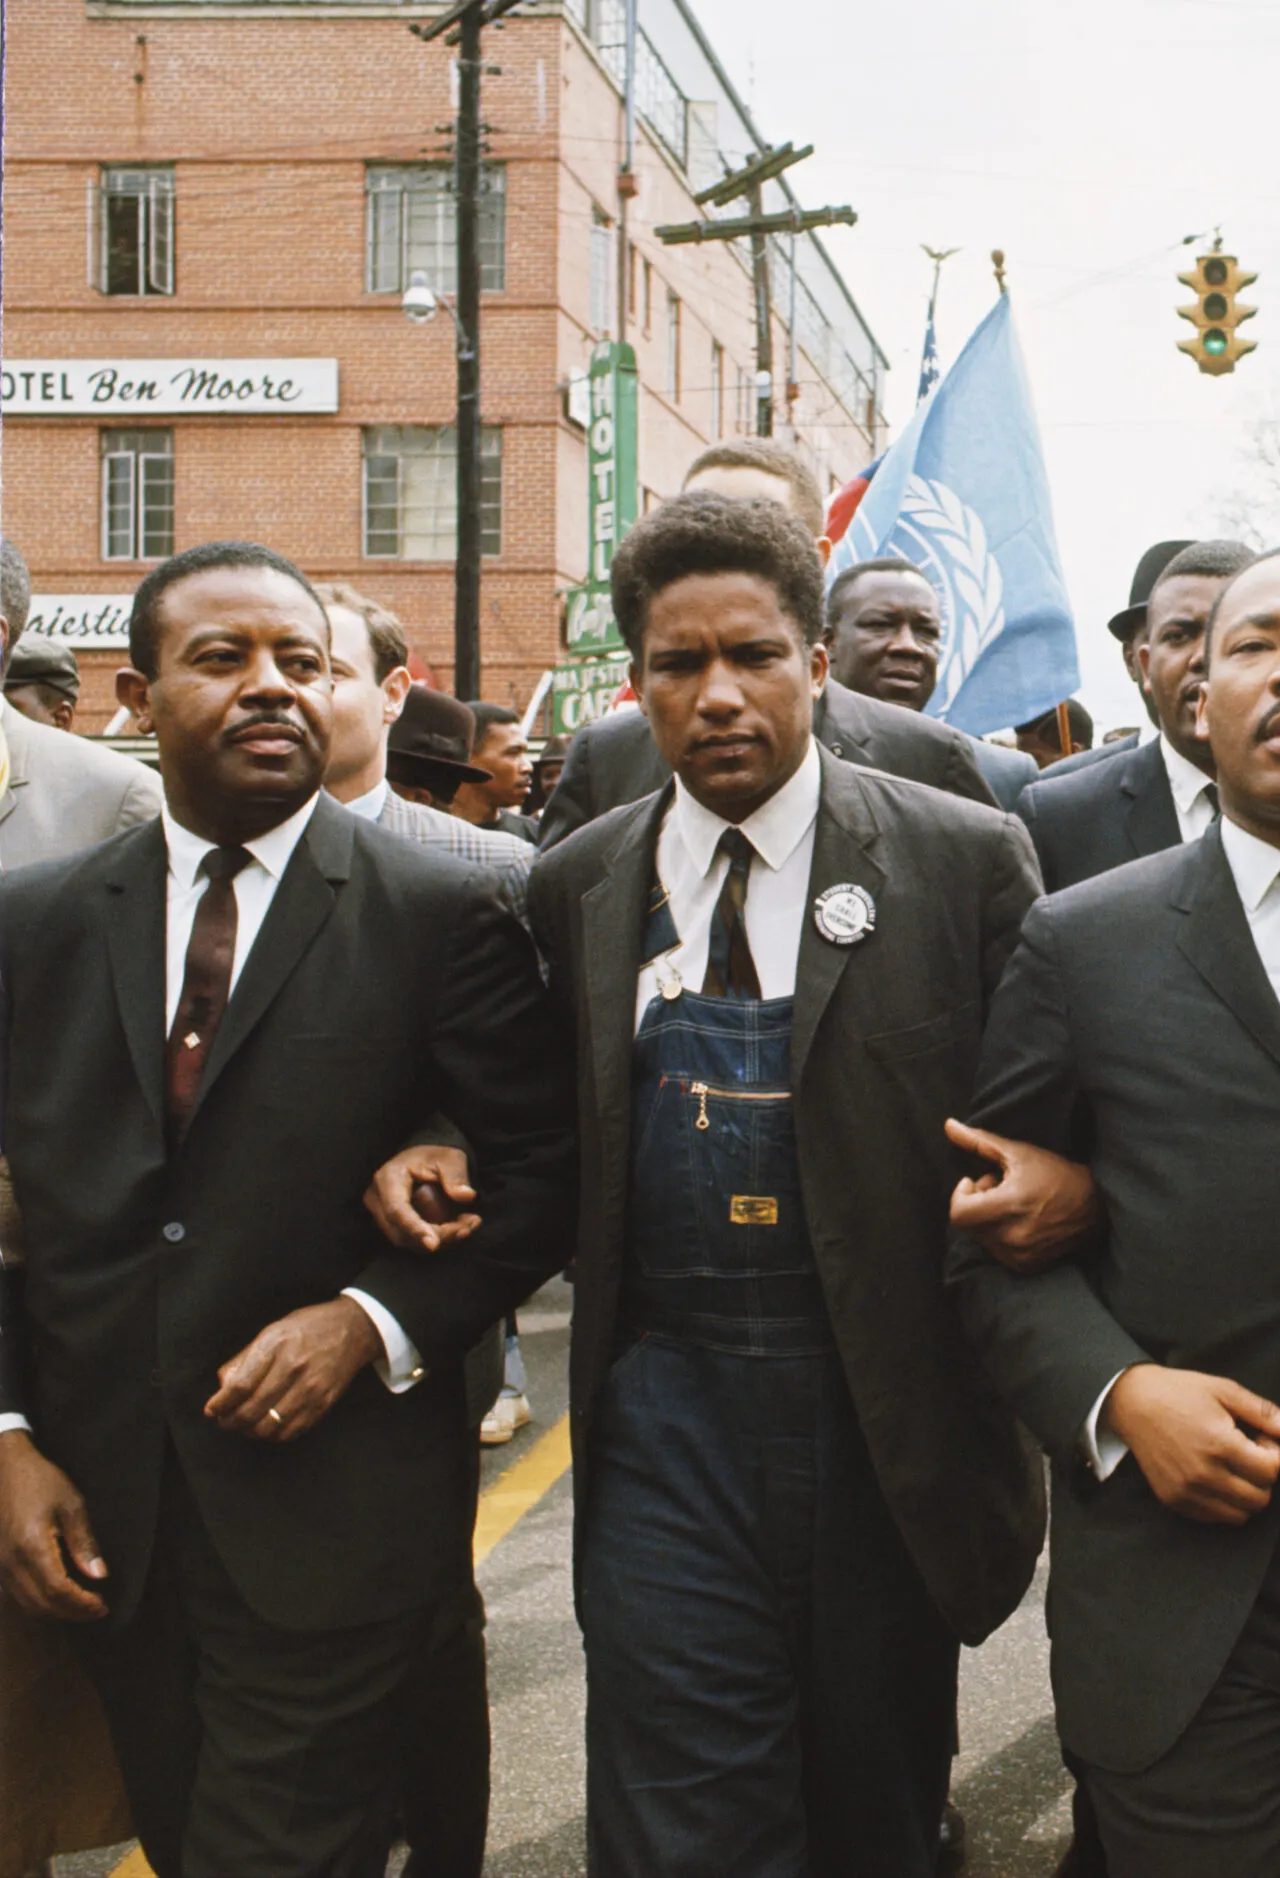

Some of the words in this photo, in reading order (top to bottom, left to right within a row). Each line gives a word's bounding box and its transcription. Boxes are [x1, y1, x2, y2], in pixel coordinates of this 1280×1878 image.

[88, 368, 161, 402] Ben
[171, 368, 302, 402] Moore
[590, 373, 615, 582] HOTEL
[562, 688, 617, 730] CAF
